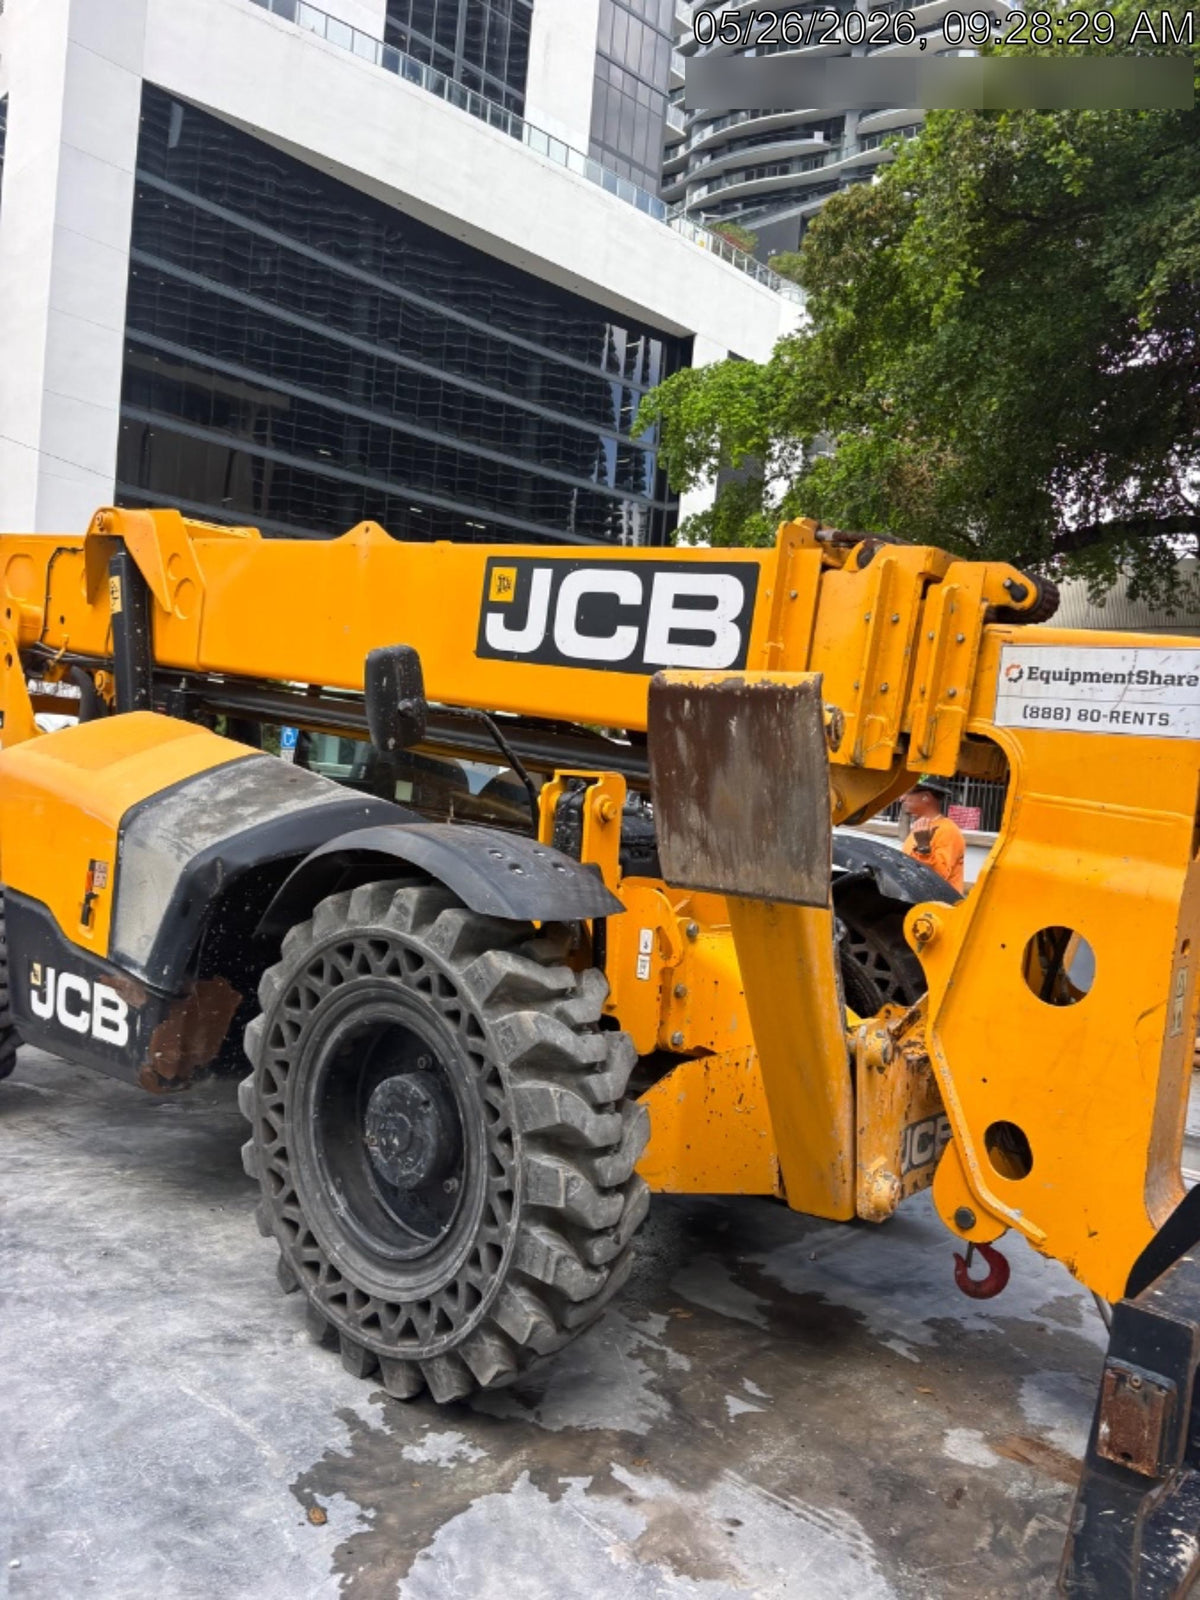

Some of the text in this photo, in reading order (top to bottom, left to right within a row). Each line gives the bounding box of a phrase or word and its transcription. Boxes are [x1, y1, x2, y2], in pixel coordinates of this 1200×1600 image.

[485, 568, 745, 669] JCB
[1026, 665, 1199, 688] EquipmentShare
[1022, 704, 1170, 726] (888) 80-RENTS
[31, 966, 129, 1046] JCB
